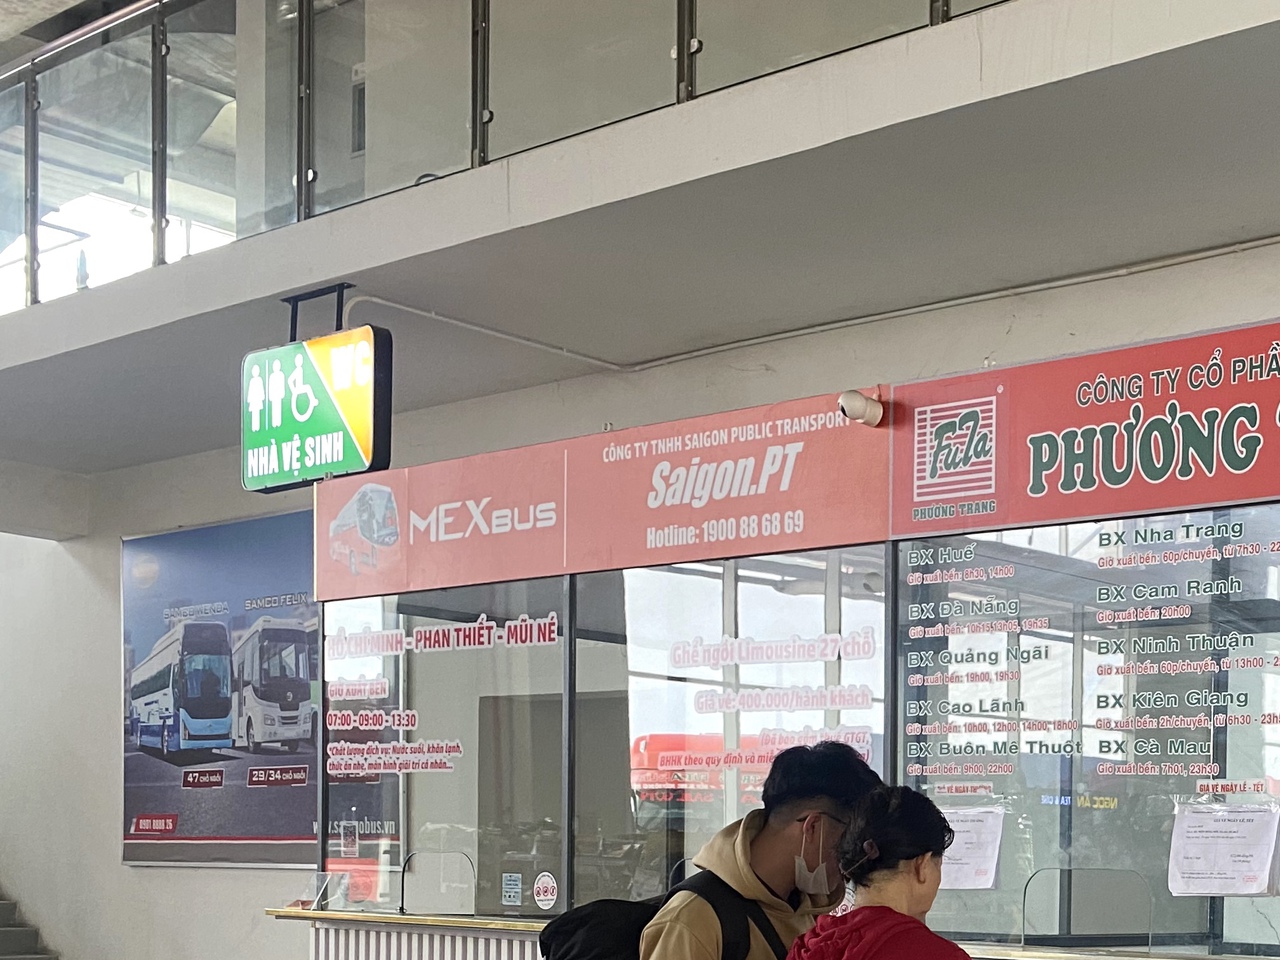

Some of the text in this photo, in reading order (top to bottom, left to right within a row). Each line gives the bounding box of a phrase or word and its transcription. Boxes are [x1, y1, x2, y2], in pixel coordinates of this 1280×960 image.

[330, 340, 370, 391] WC
[1077, 372, 1143, 407] CÔNG
[1151, 369, 1180, 395] TY
[1187, 348, 1225, 388] CỔ
[248, 431, 343, 477] NHÀ VỆ SINH
[602, 442, 631, 463] CÔNG
[634, 441, 648, 457] TY
[651, 436, 682, 456] TNHH
[684, 431, 728, 452] SAIGON
[731, 423, 773, 444] PUBLIC
[1027, 400, 1263, 498] PHƯƠNG
[647, 442, 804, 508] Saigon.PT
[912, 499, 996, 520] PHƯƠNG TRANG
[646, 510, 804, 549] Hotline: 1900 88 68 69
[1099, 522, 1244, 547] BX Nha Trang
[908, 543, 977, 565] BX Huế
[280, 593, 307, 605] FELIX
[371, 632, 403, 652] MINH
[415, 628, 450, 649] PHAN
[454, 615, 494, 647] THIẾT
[507, 620, 533, 645] MŨI
[537, 614, 556, 643] NÉ
[673, 637, 699, 664] Ghế
[738, 638, 815, 662] Limousine
[820, 638, 838, 658] 27
[843, 628, 872, 657] chỗ
[1098, 632, 1255, 655] BX Ninh Thuận
[1097, 690, 1249, 709] BX Kiên Giang
[328, 714, 351, 726] 07:00
[359, 714, 383, 726] 09:00
[392, 714, 416, 726] 13:30
[187, 773, 198, 783] 47
[252, 770, 281, 781] 29/34
